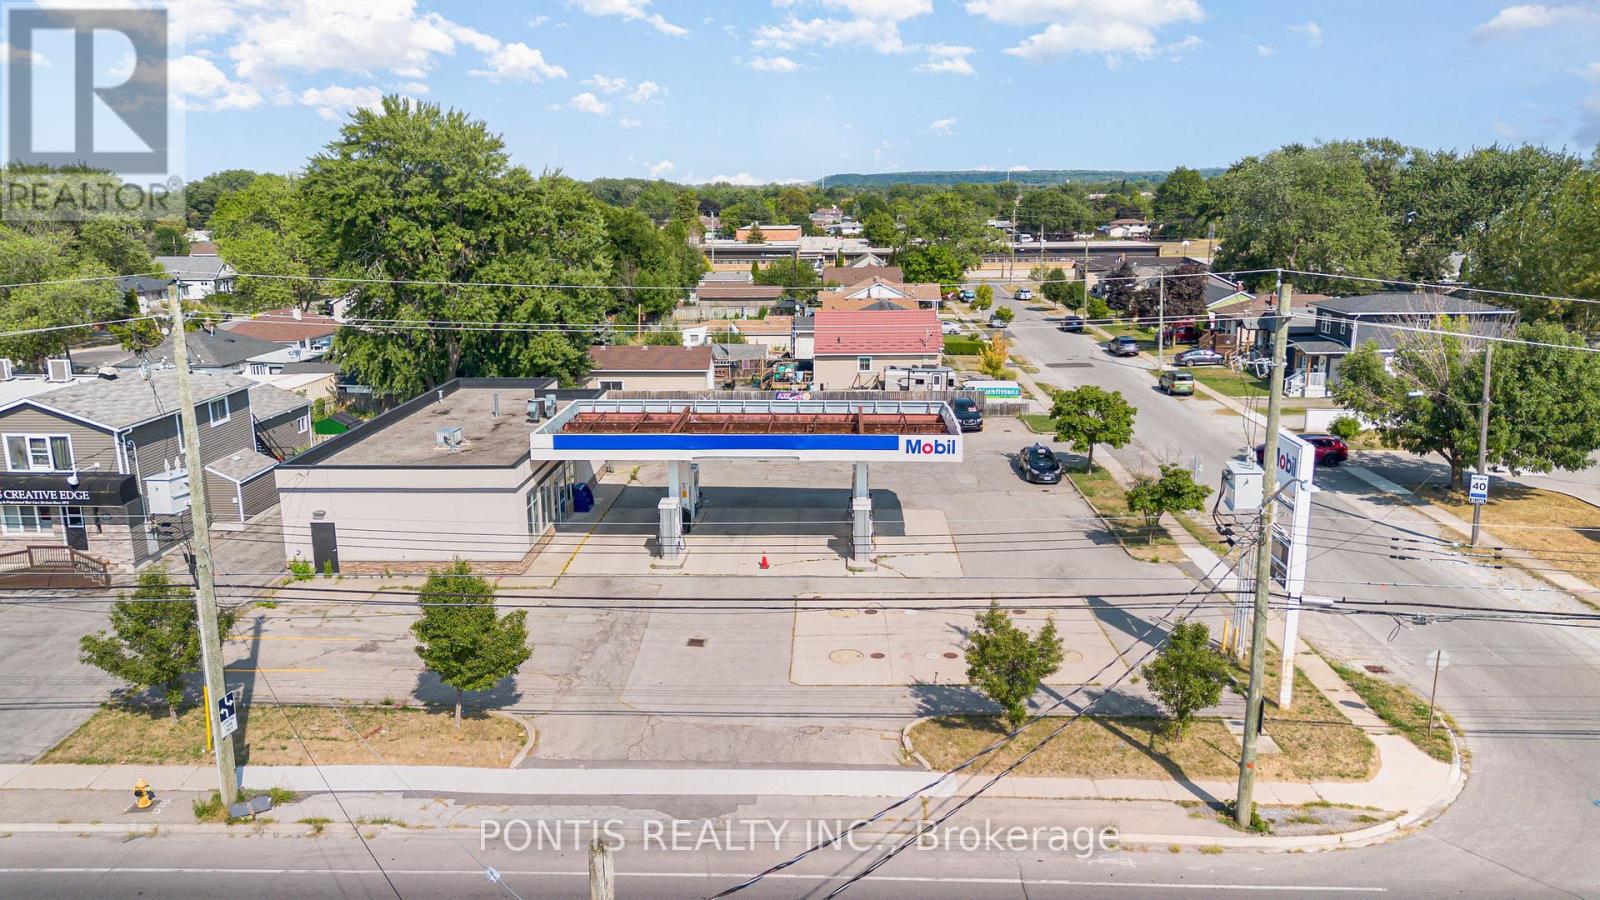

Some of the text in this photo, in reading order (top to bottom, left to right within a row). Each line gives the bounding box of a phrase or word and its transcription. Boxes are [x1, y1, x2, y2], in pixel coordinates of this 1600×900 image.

[905, 439, 956, 455] Mobil
[1472, 482, 1486, 491] 40
[3, 490, 58, 500] CREATIVE
[59, 490, 90, 500] EDGE
